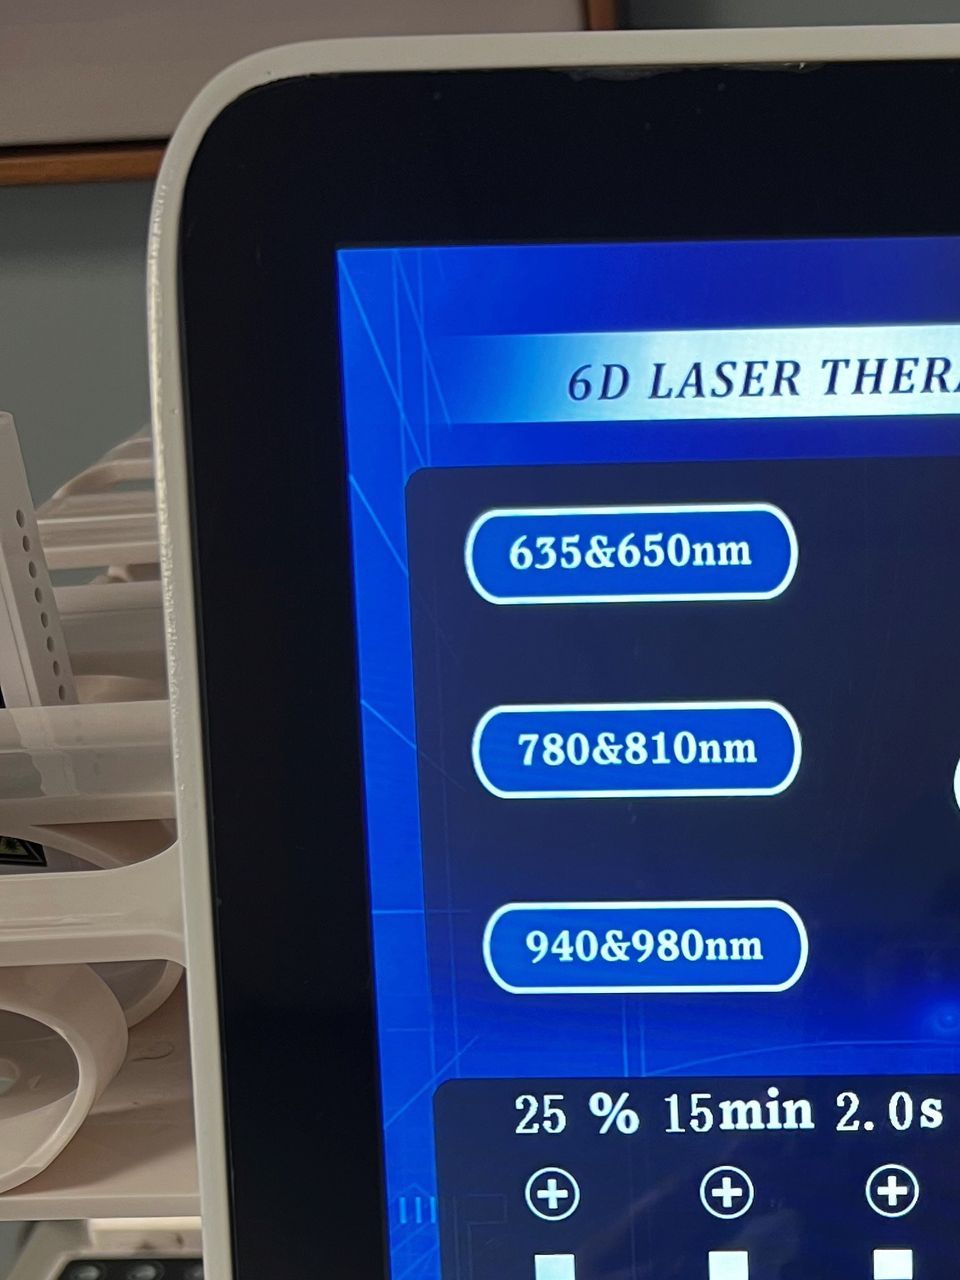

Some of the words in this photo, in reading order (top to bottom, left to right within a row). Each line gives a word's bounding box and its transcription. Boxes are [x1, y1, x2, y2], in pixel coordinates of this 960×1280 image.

[568, 364, 629, 401] 6D
[649, 360, 800, 399] LASER
[509, 532, 753, 570] 635&650nm
[518, 730, 758, 766] 780&810nm
[525, 928, 764, 964] 940&980nm
[515, 1094, 567, 1134] 25
[588, 1091, 640, 1135] %
[664, 1086, 815, 1133] 15min
[835, 1091, 944, 1131] 2.0s
